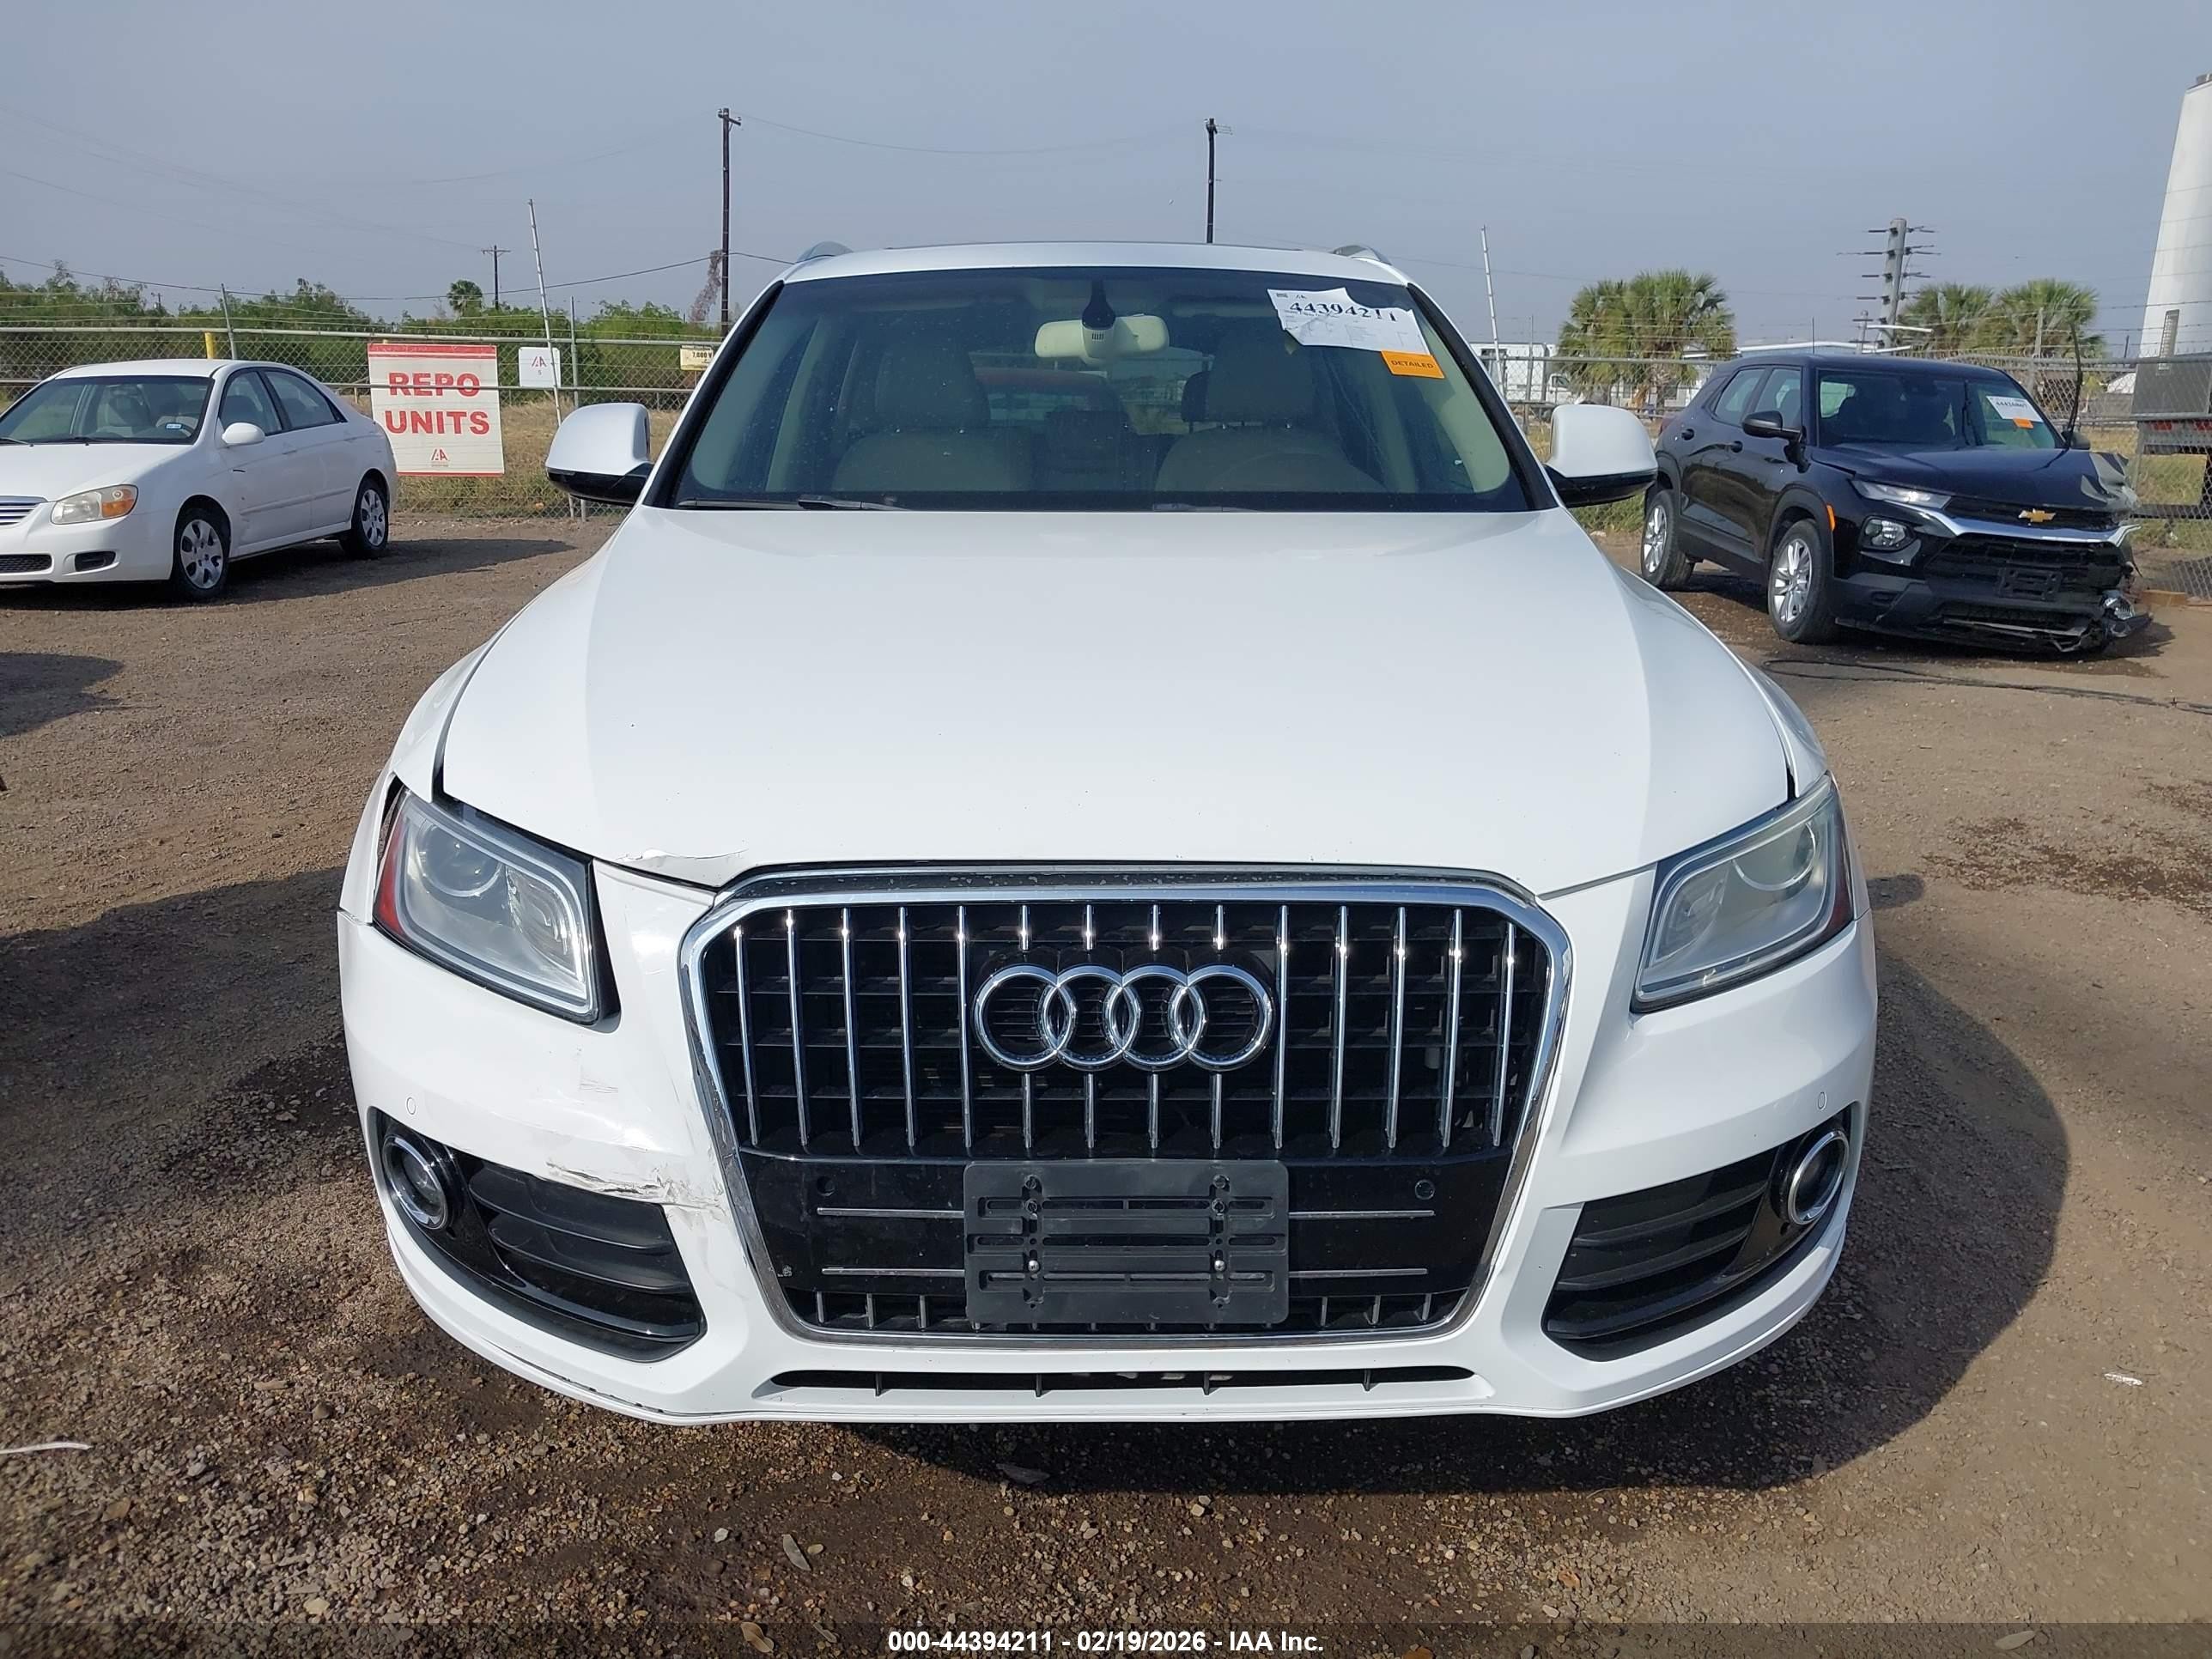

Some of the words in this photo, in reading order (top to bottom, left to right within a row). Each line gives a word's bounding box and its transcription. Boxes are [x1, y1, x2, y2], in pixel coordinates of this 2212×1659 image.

[1290, 302, 1396, 322] 44394211
[1390, 360, 1434, 369] DETAILED
[388, 372, 480, 397] REPO
[384, 410, 489, 435] UNITS
